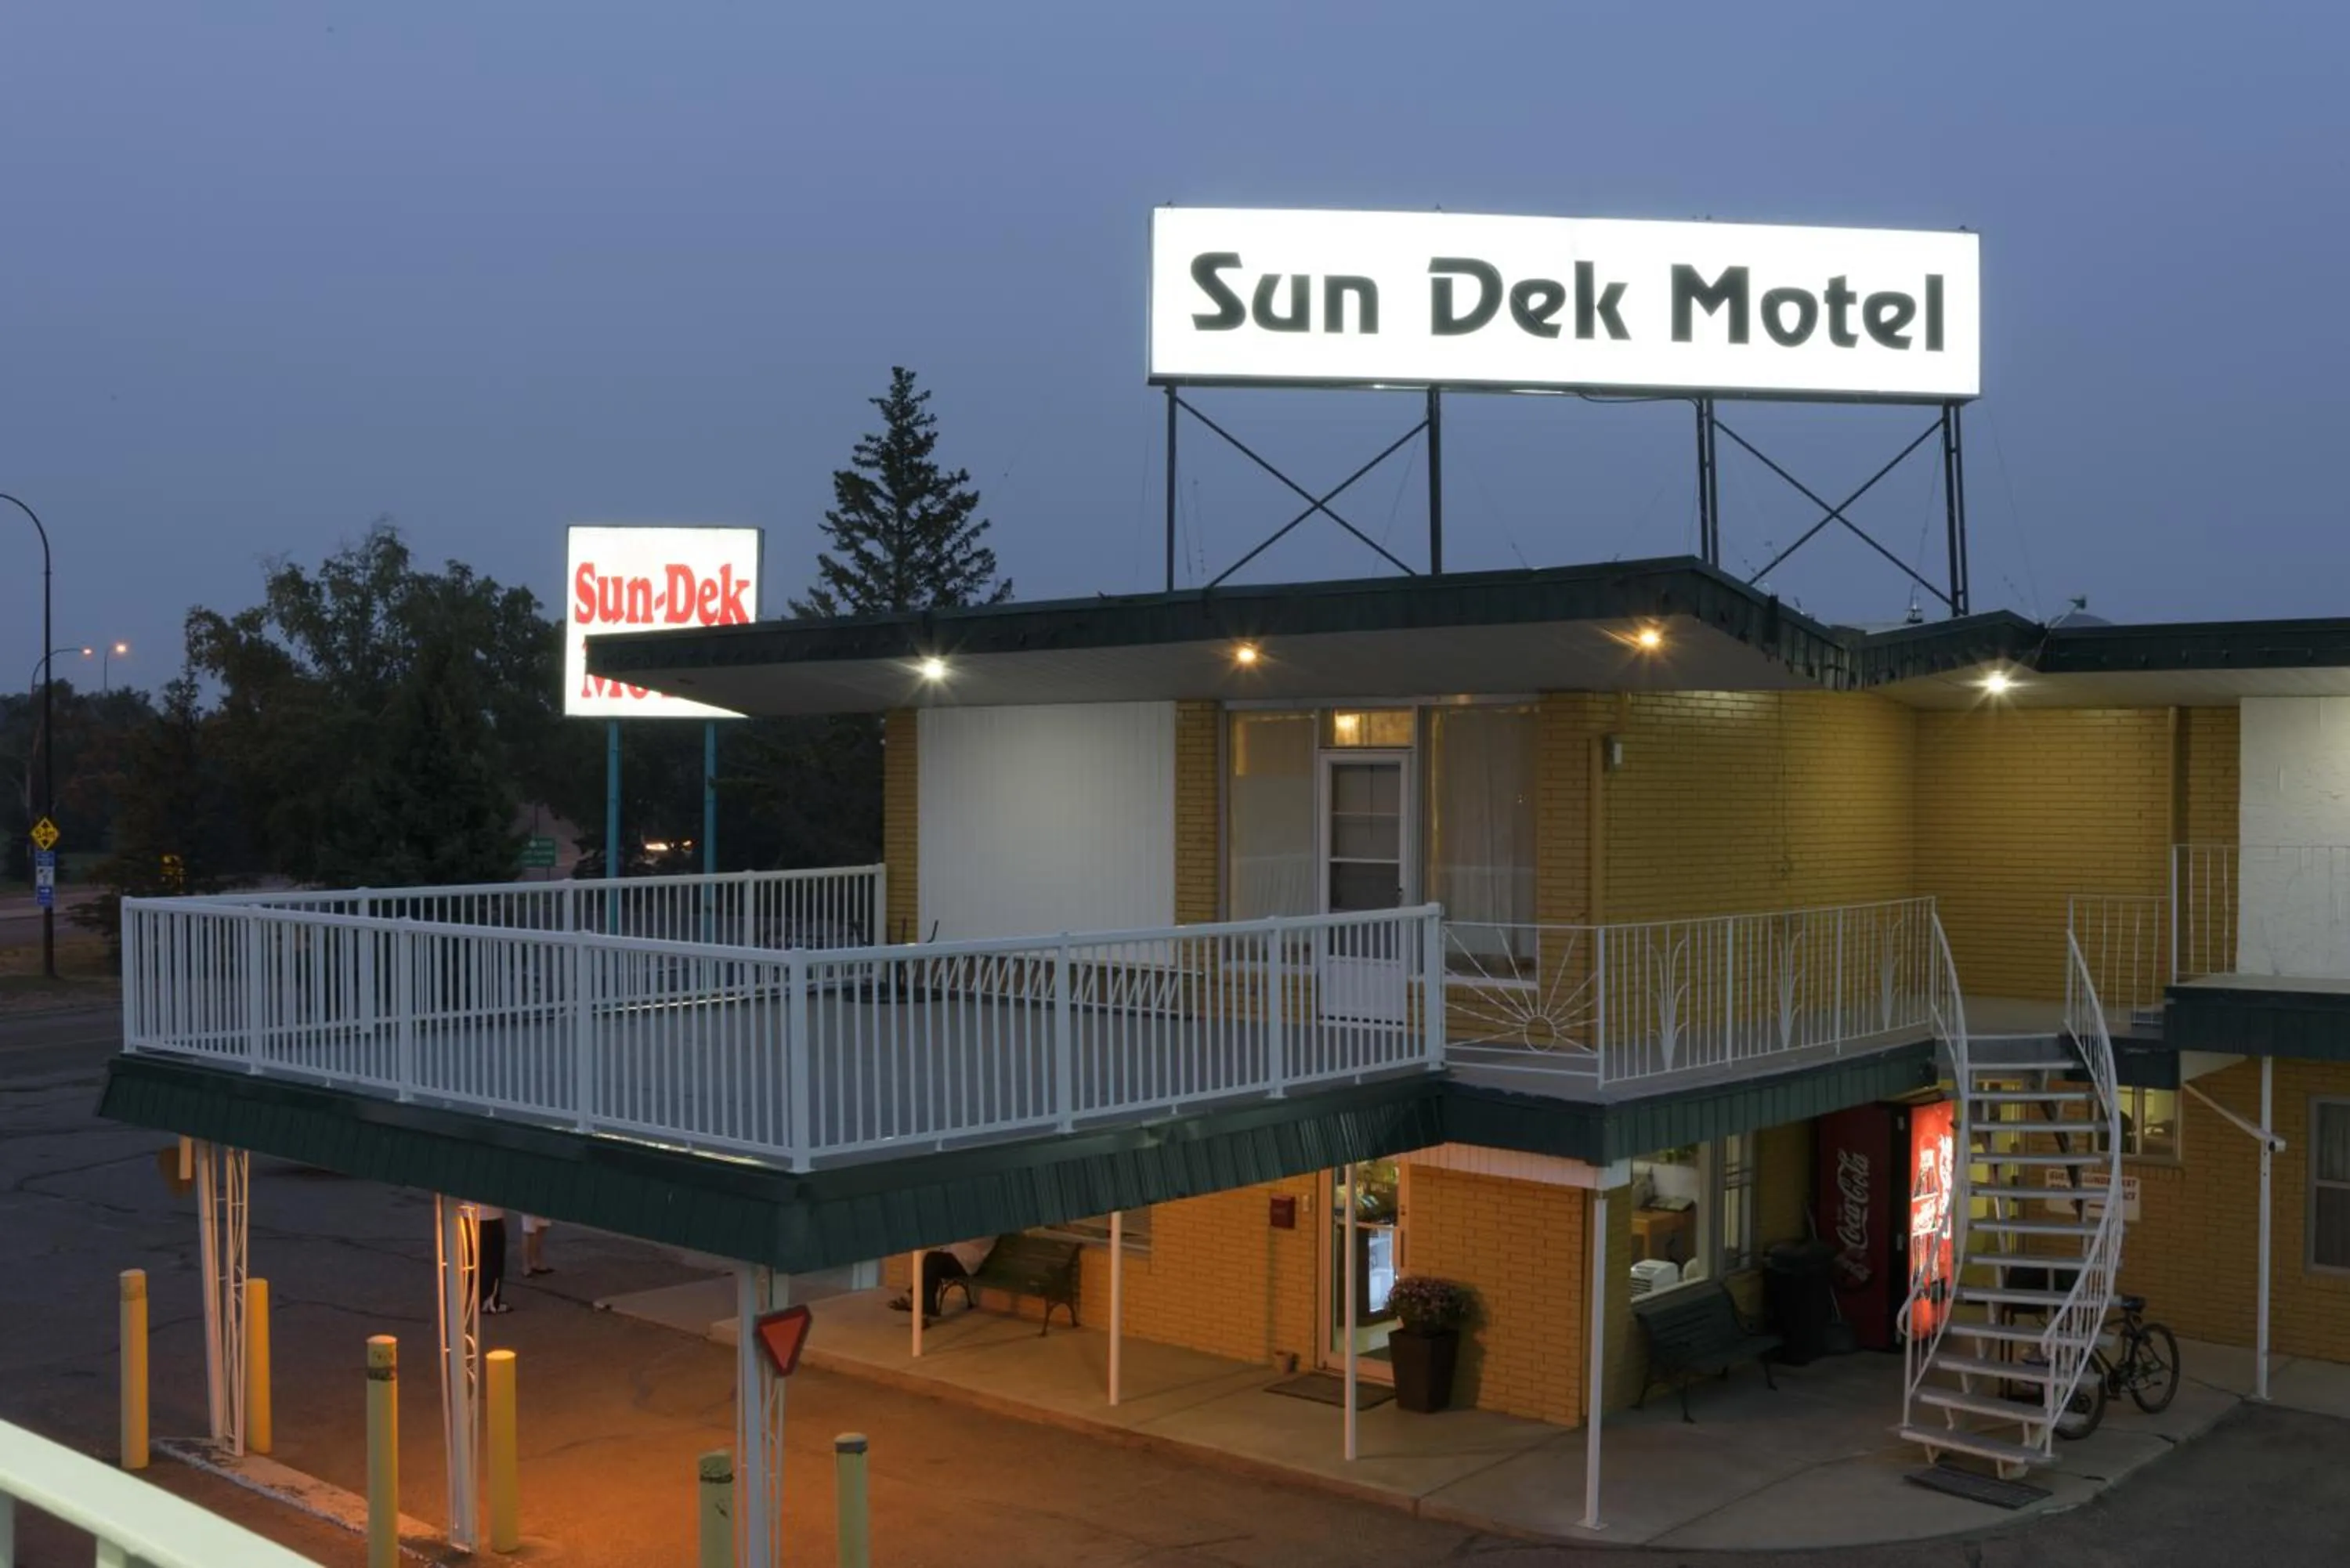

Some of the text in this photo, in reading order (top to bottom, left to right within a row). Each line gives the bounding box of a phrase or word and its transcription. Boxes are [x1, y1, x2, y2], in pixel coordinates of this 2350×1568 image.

[1190, 251, 1944, 352] Sun Dek Motel
[574, 562, 750, 626] Sun-Dek
